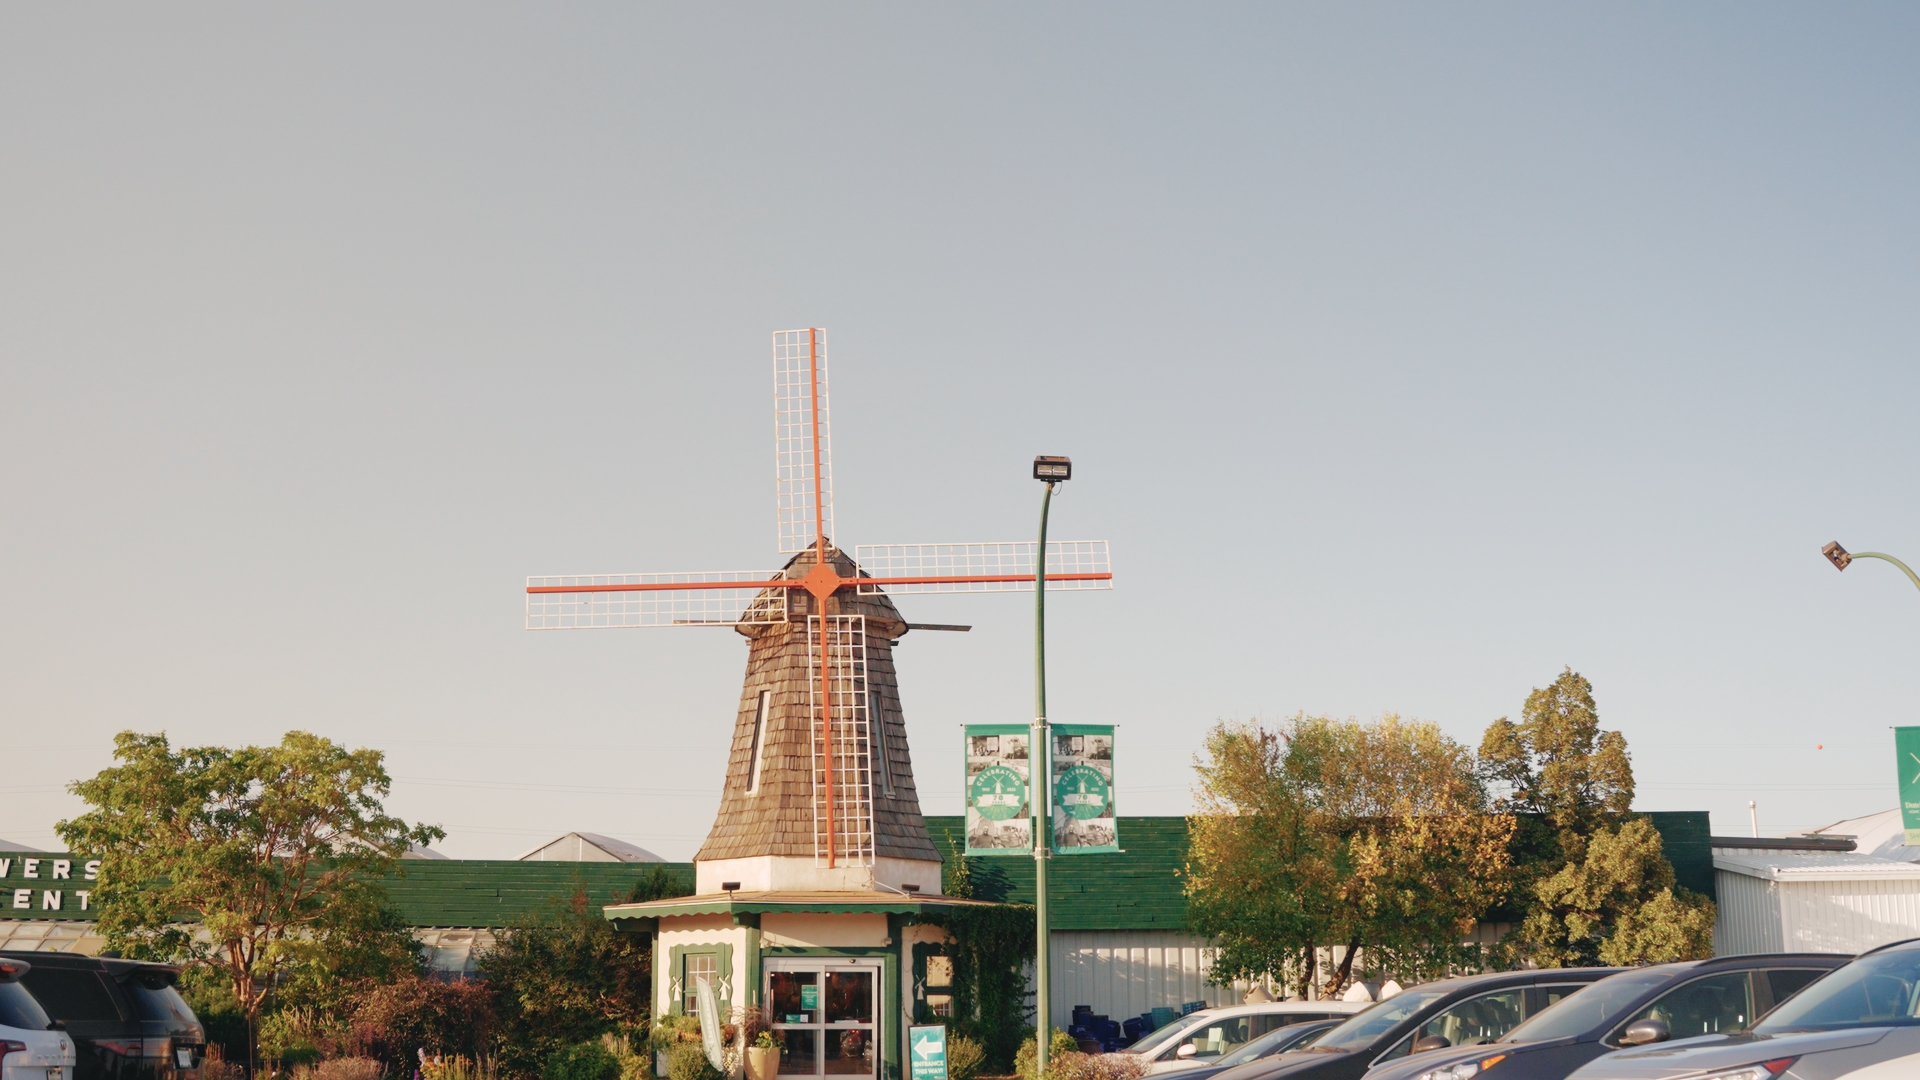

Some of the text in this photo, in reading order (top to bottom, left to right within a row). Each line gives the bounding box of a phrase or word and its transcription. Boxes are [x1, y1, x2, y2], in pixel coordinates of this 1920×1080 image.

[976, 768, 1021, 787] CELEBRATING
[1061, 768, 1104, 786] CELEBRATING
[13, 888, 91, 911] ENT
